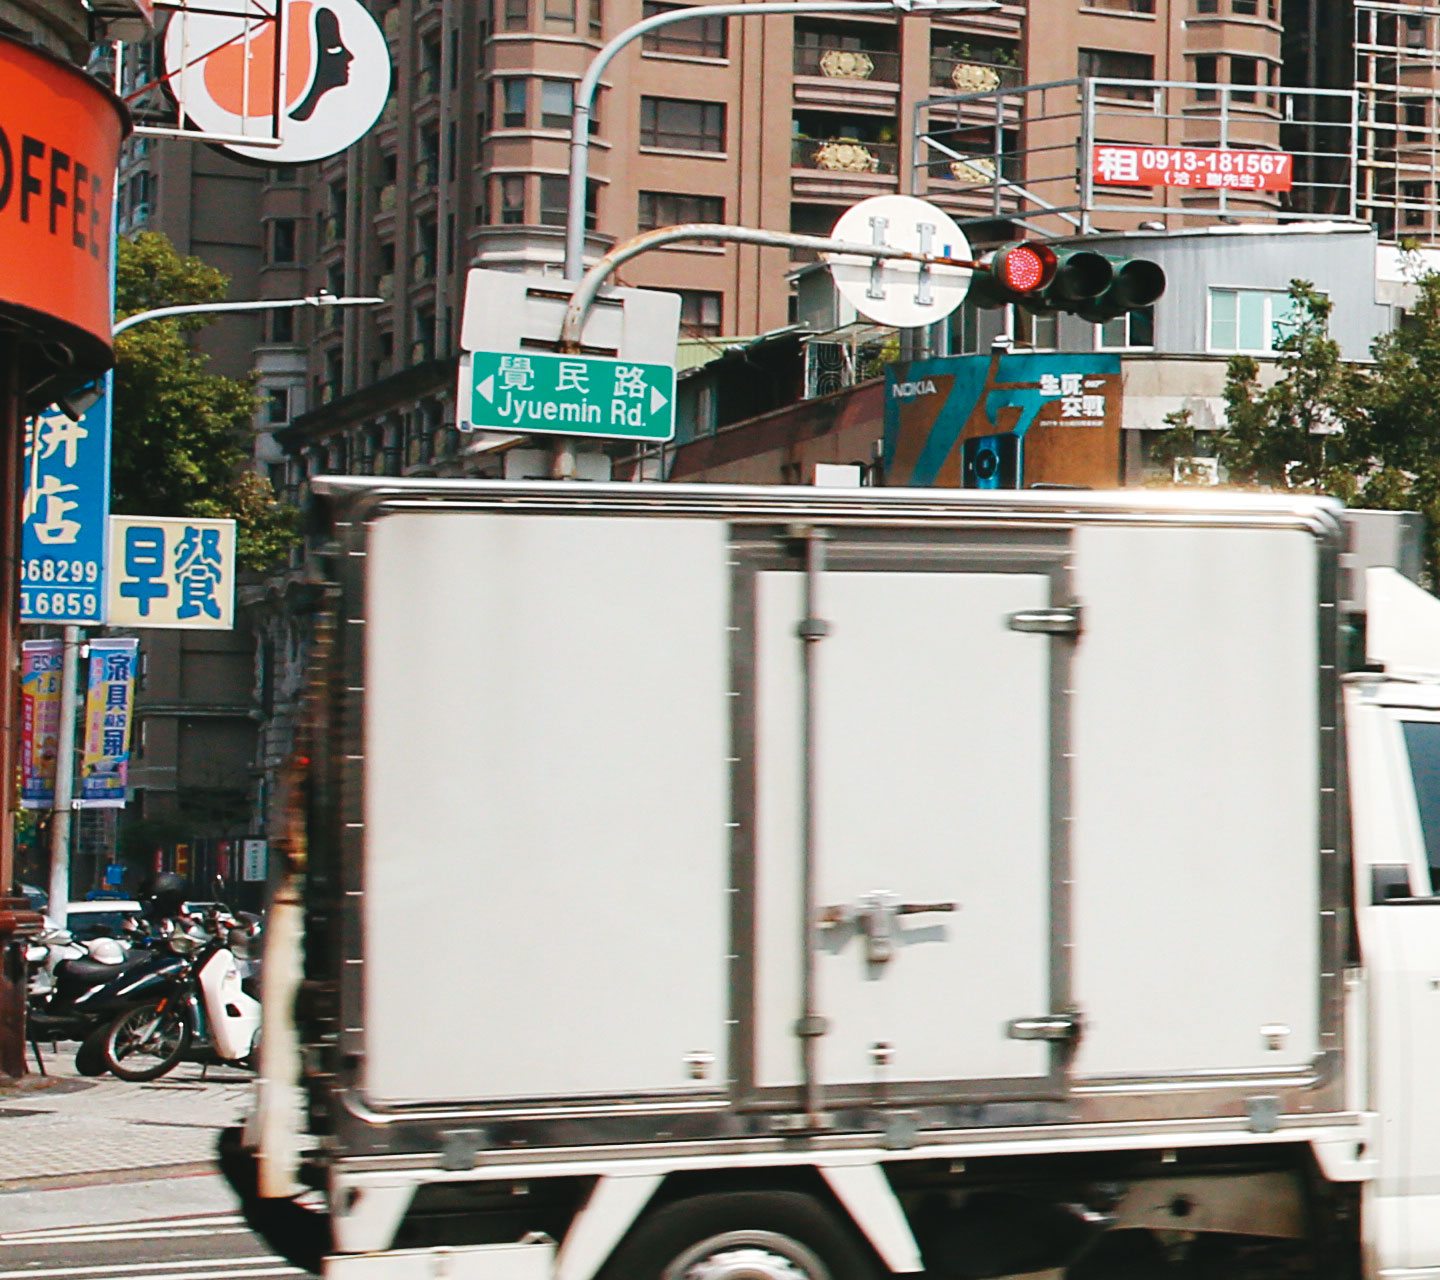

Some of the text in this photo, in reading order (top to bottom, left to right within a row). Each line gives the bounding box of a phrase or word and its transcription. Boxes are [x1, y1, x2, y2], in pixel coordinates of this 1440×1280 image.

[1098, 148, 1288, 181] 租 0913-181567
[498, 356, 648, 398] 覺民路
[892, 380, 937, 398] NOKIA
[498, 392, 646, 426] Jyuemin Rd.
[120, 526, 222, 619] 早餐
